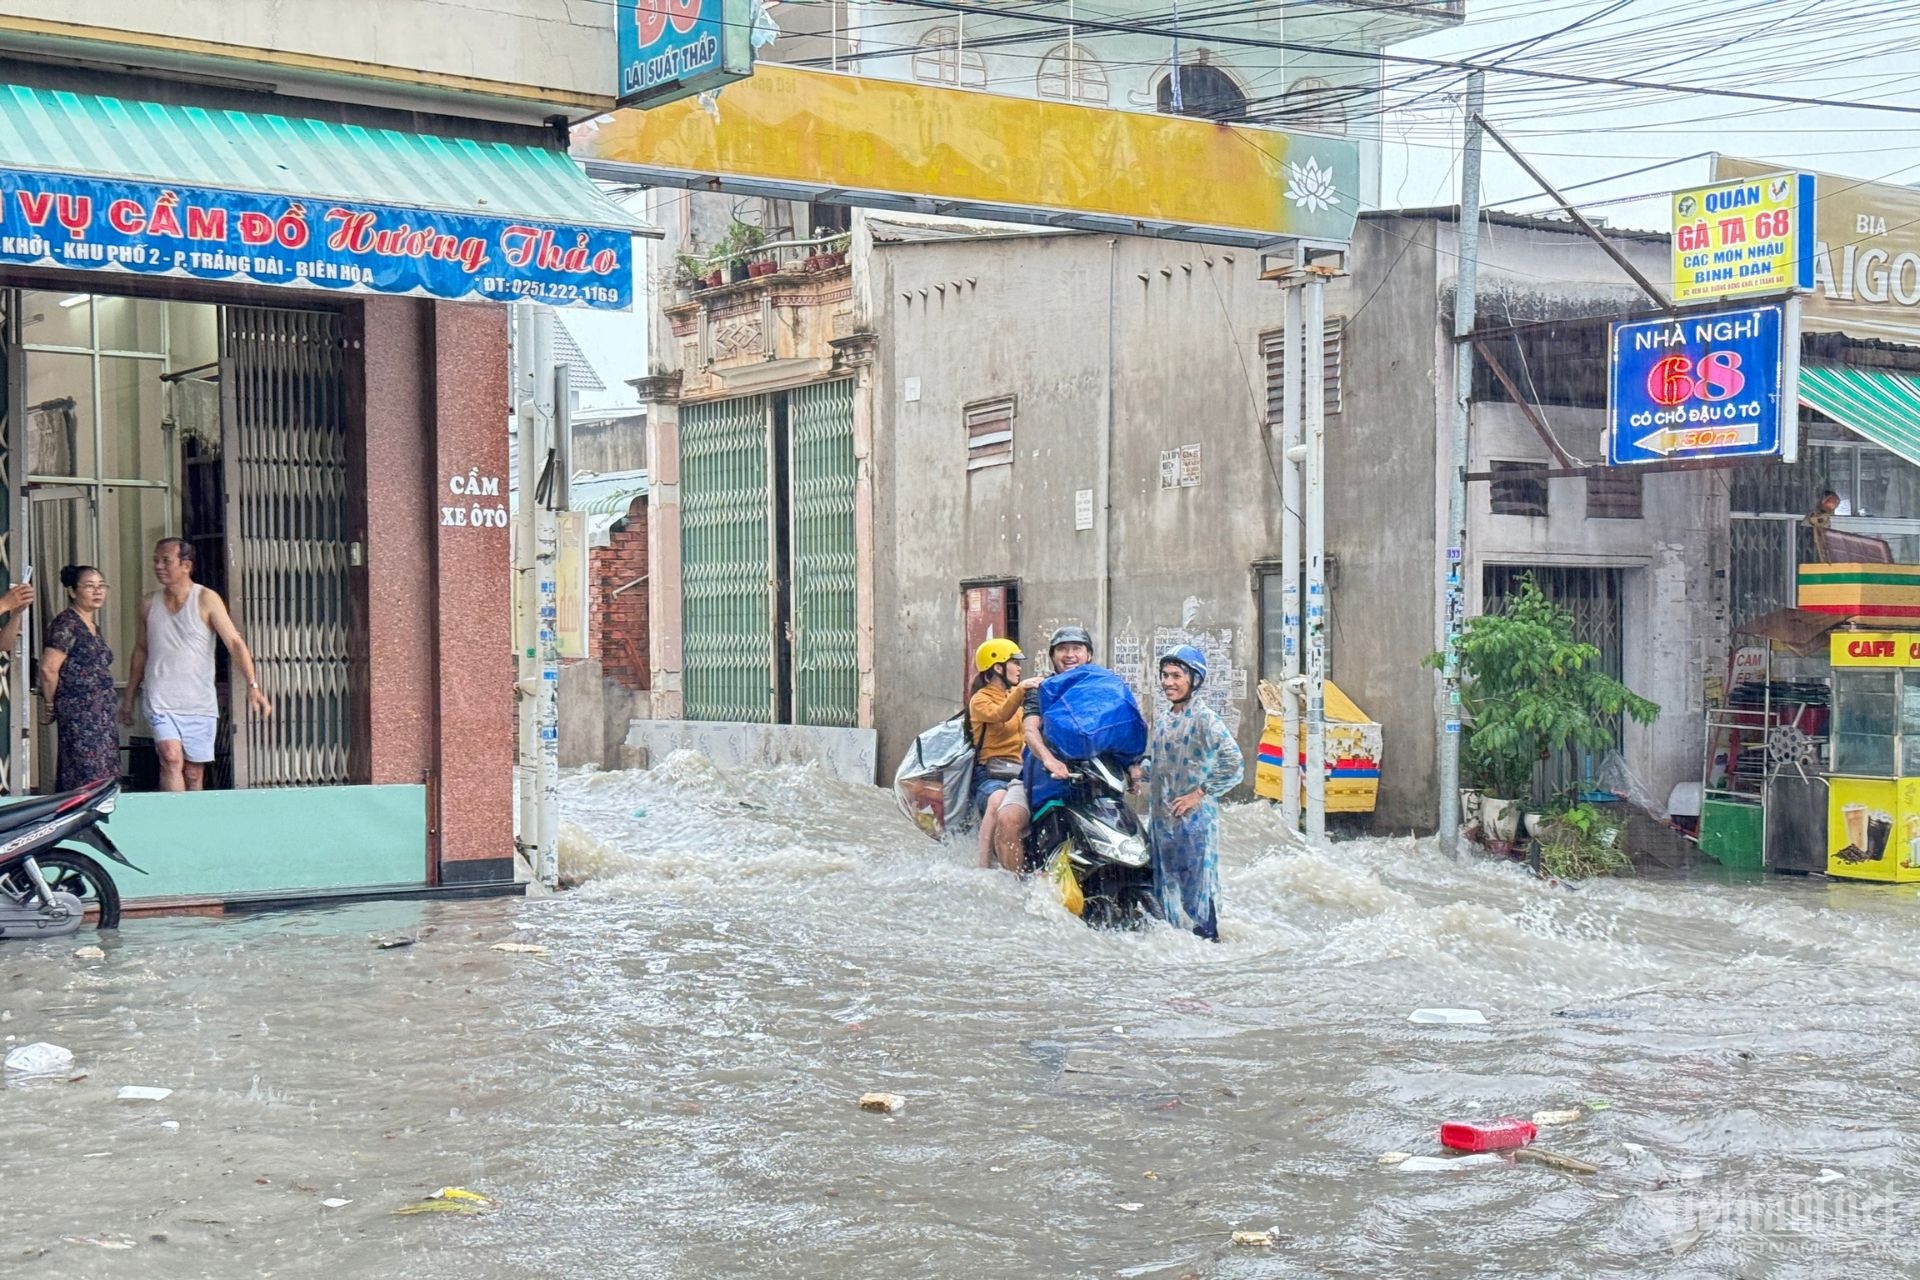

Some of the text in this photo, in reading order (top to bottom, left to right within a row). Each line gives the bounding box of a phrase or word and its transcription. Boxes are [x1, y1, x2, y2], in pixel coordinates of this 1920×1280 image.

[625, 31, 717, 93] LÃI SUẤT THẤP
[17, 190, 92, 240] VỤ
[108, 190, 227, 242] CẦM
[238, 202, 310, 249] ĐỒ
[324, 206, 489, 273] Hương
[500, 224, 619, 276] Thảo
[1677, 209, 1789, 252] GÀ TA 68
[1855, 213, 1888, 236] BIA
[64, 242, 103, 260] KHU
[107, 243, 149, 263] PHỐ
[149, 248, 160, 265] 2
[189, 249, 250, 273] TRẢNG
[254, 256, 283, 275] DÀI
[296, 259, 337, 279] BIÊN
[340, 263, 374, 283] HÒA
[1635, 313, 1761, 351] NHÀ NGHỈ
[1647, 350, 1745, 405] 68
[1630, 401, 1761, 427] CÓ CHỖ ĐẬU Ô TÔ
[449, 466, 499, 496] CẦM
[441, 502, 508, 528] XE ÔTÔ
[1736, 654, 1762, 668] CAM
[1848, 641, 1896, 658] CAFE
